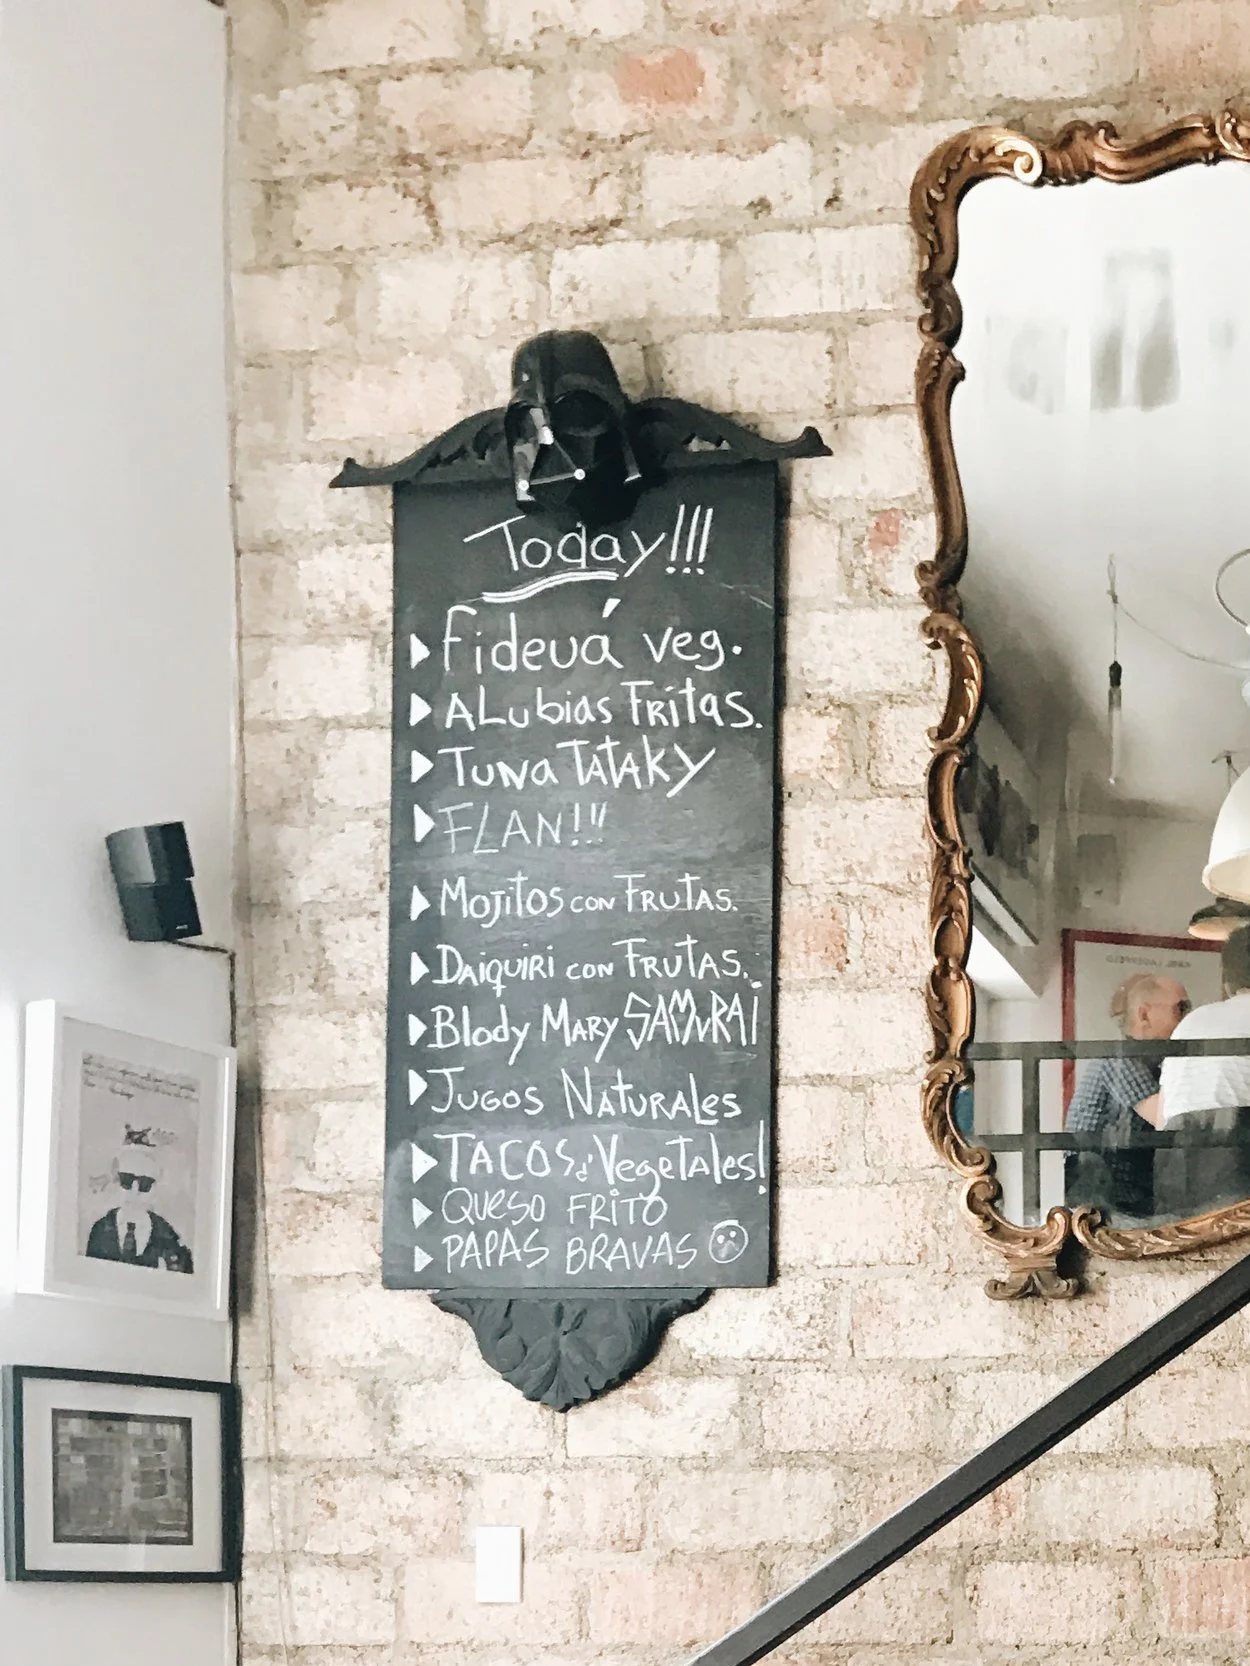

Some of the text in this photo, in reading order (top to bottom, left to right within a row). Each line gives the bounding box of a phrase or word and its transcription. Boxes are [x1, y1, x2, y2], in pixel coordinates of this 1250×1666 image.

[463, 504, 713, 577] Today!!!
[643, 627, 743, 671] veg.
[427, 1004, 531, 1066] Blody
[441, 1227, 697, 1275] PAPAS BRAVAS
